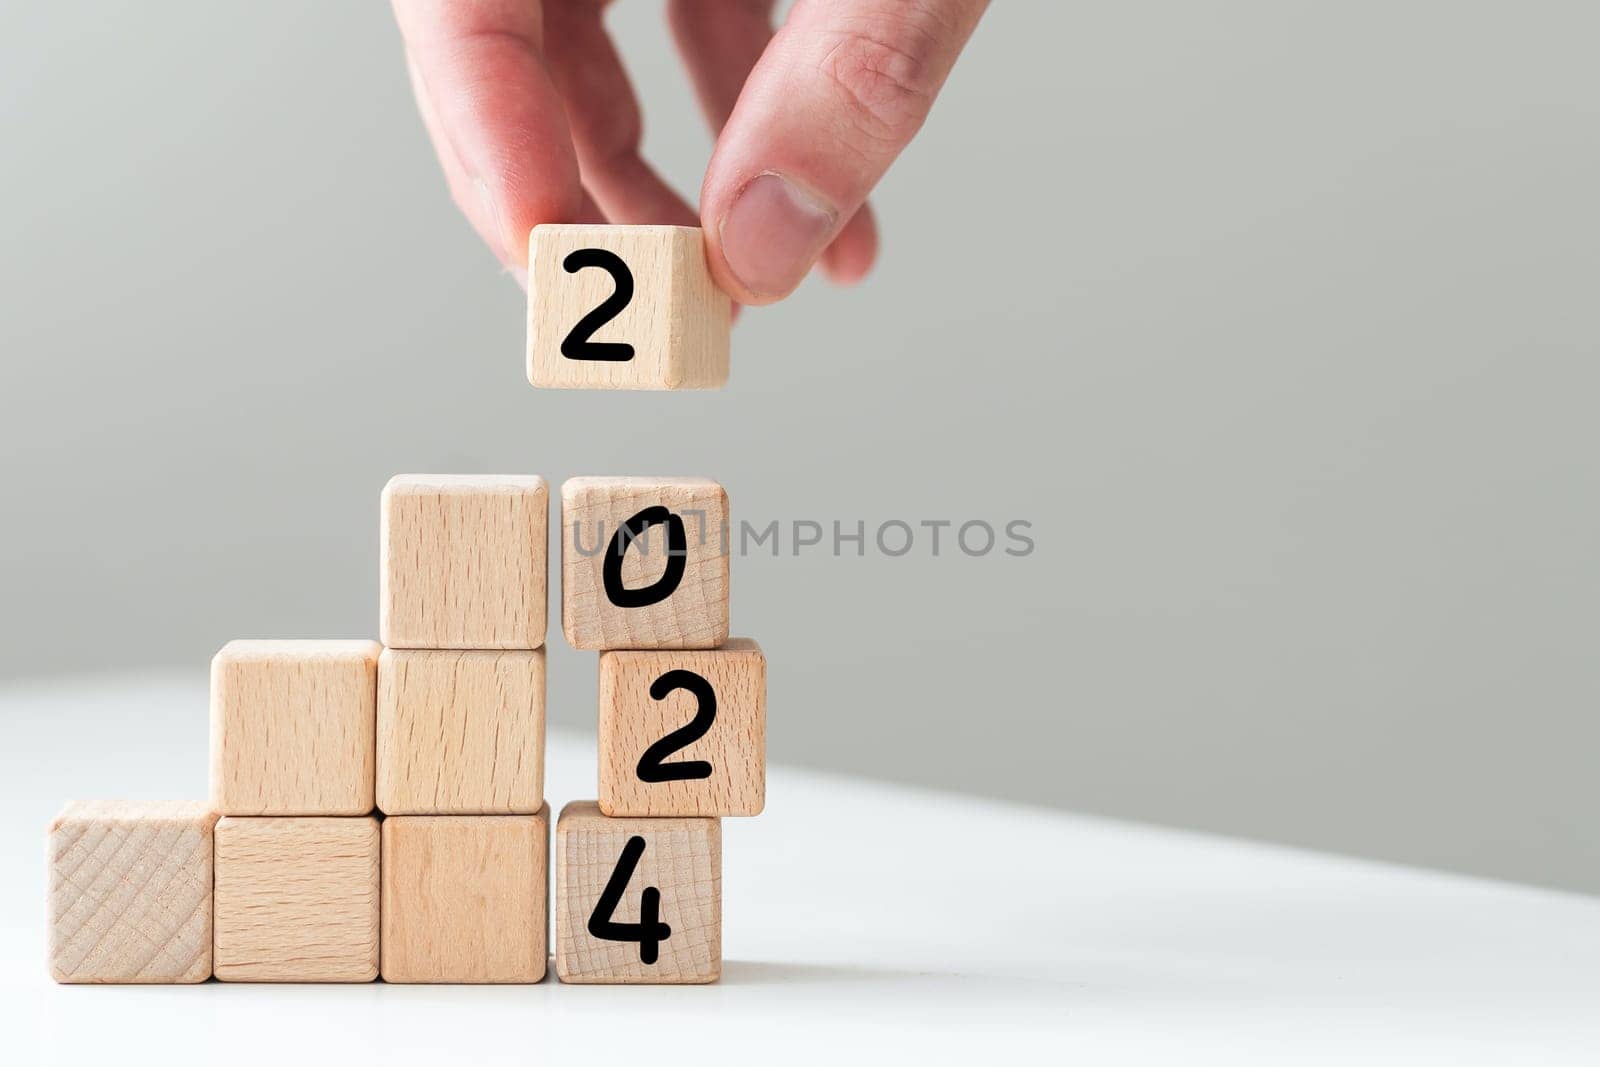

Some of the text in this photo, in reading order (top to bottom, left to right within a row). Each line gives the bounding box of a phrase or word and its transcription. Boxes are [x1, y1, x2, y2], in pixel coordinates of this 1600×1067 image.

[561, 248, 635, 362] 2
[603, 505, 687, 608] 0
[636, 669, 717, 783] 2
[587, 835, 672, 965] 4
